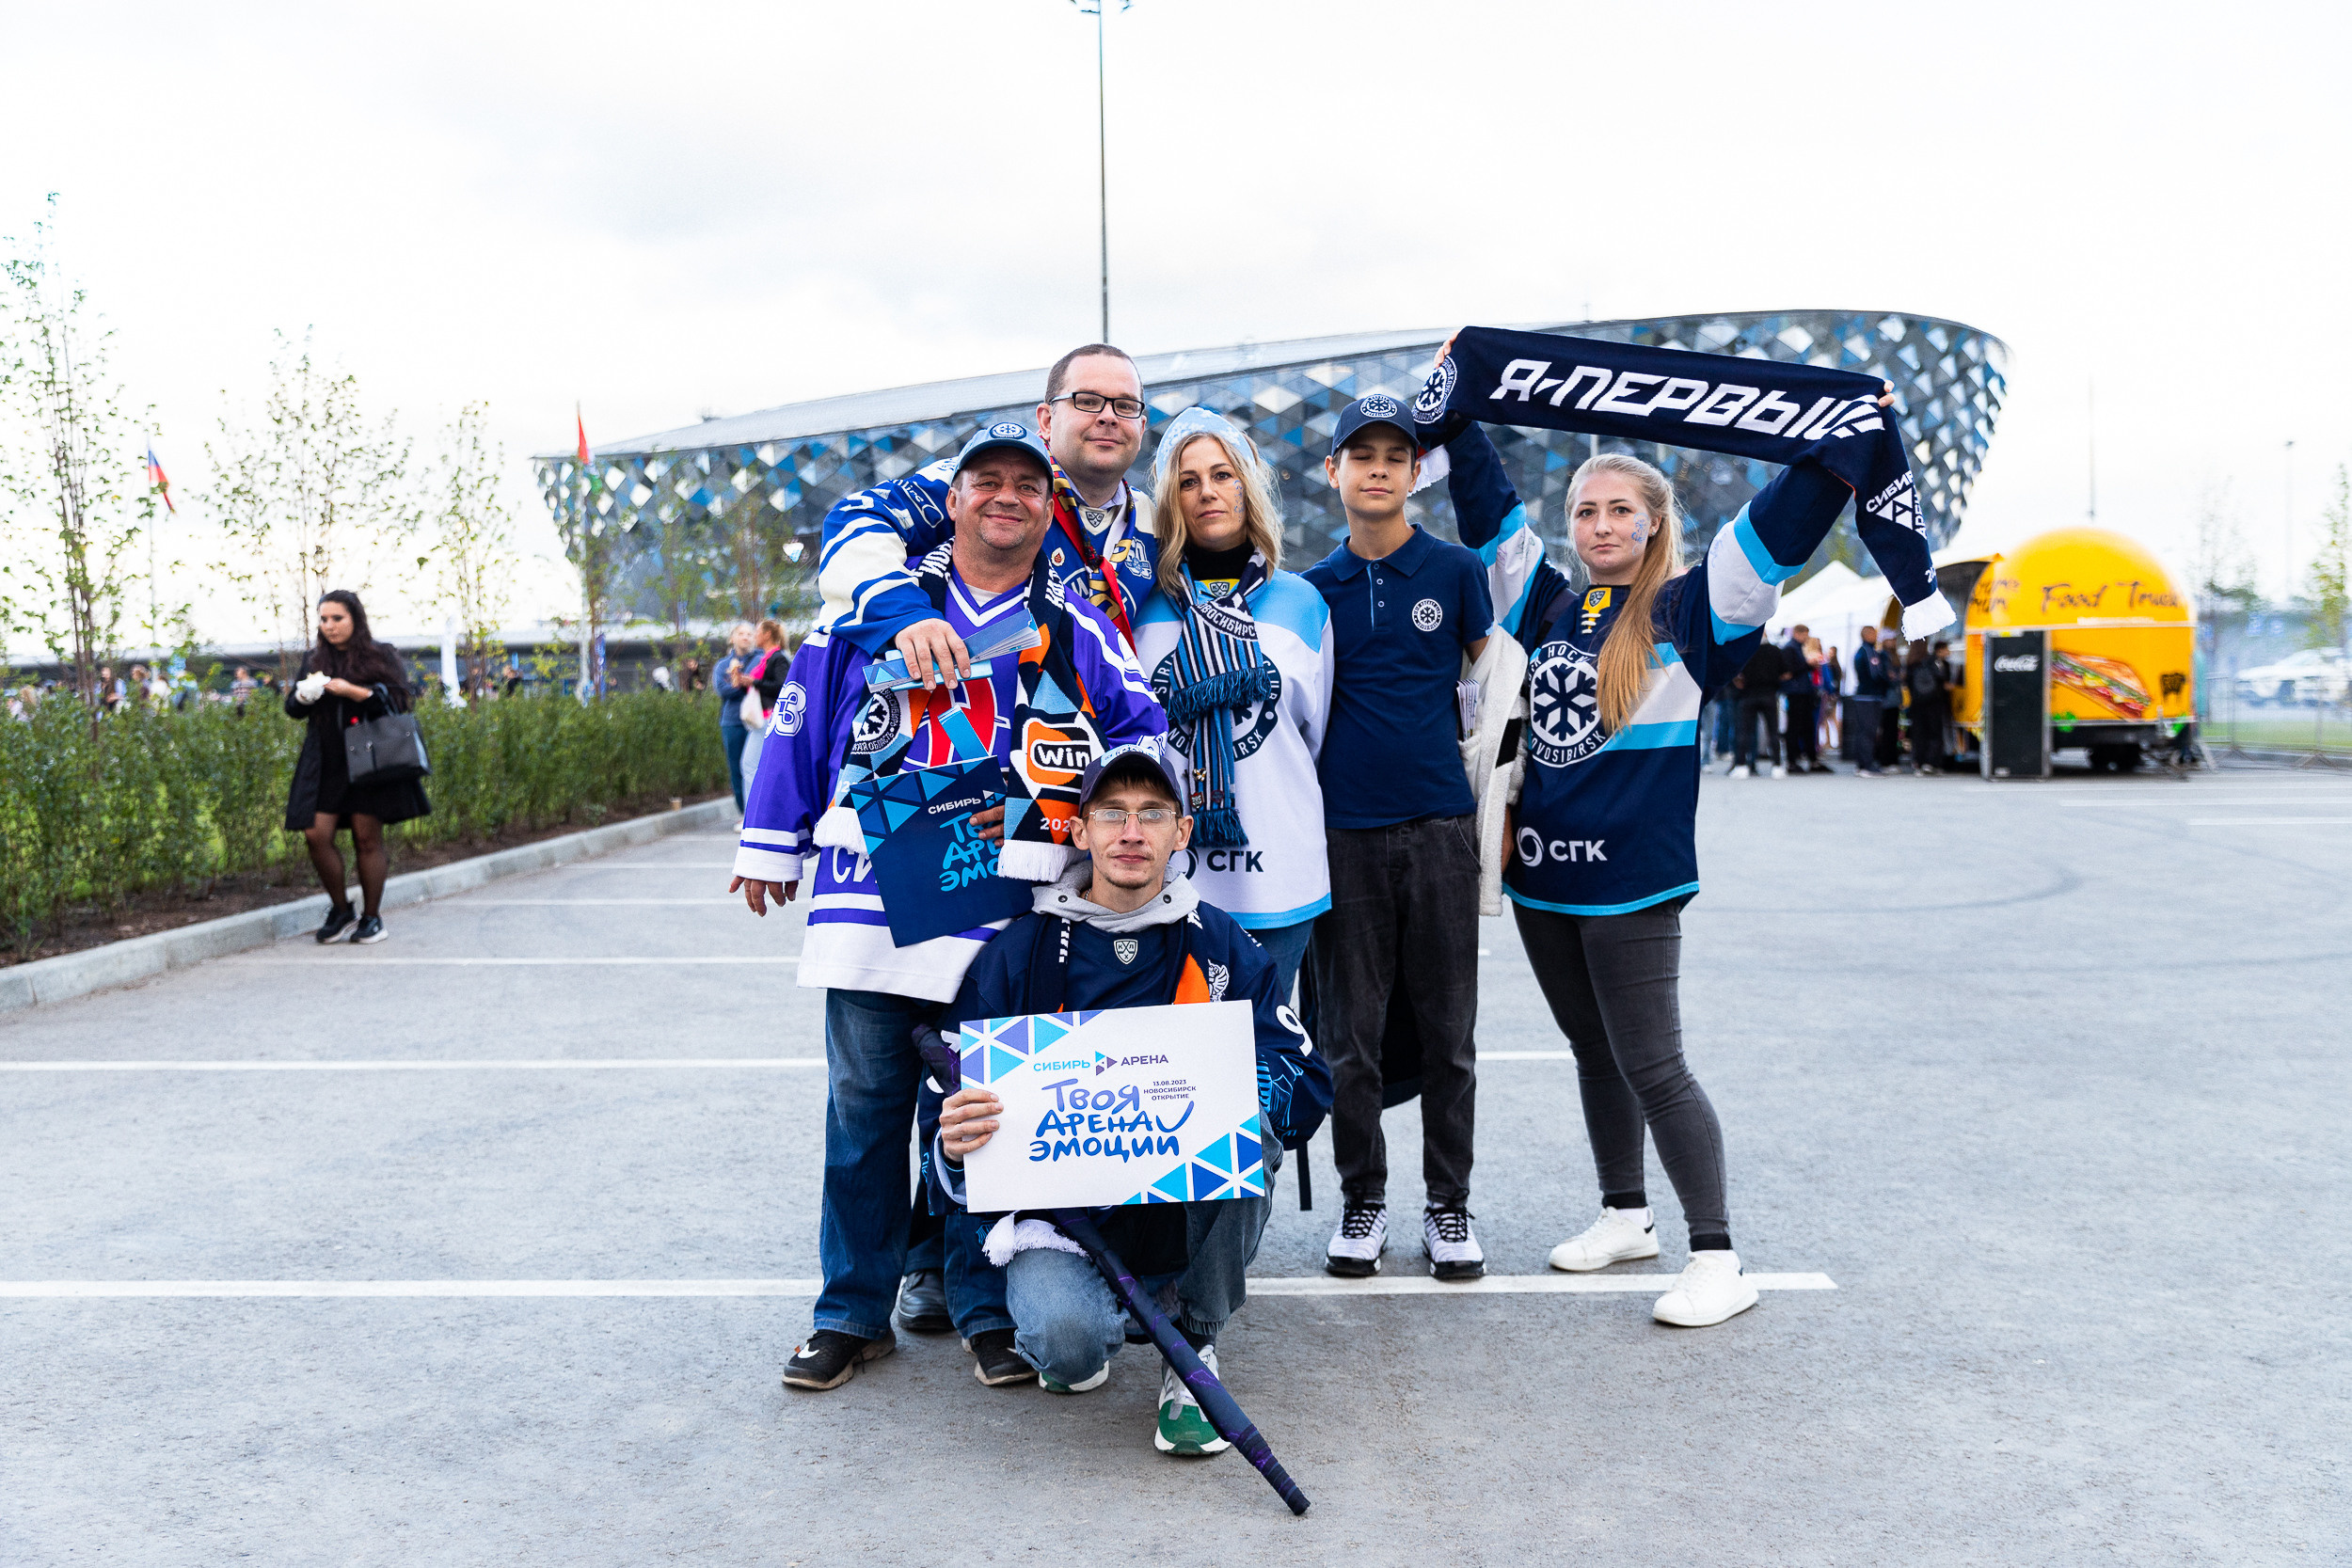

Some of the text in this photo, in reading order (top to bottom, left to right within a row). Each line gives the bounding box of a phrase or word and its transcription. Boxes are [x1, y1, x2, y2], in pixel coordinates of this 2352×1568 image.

[2041, 582, 2108, 613] Food
[1531, 730, 1606, 763] OVOSIBIRSK
[928, 798, 981, 815] СИБИРЬ
[1206, 849, 1263, 873] СГК
[1549, 840, 1608, 862] СГК
[1033, 1054, 1169, 1072] СИБИРЬ АРЕНА
[1143, 1085, 1197, 1094] НОВОСИБИРСК
[1151, 1093, 1190, 1101] ОТКРЫТИЕ
[1036, 1109, 1153, 1138] АРЕНА
